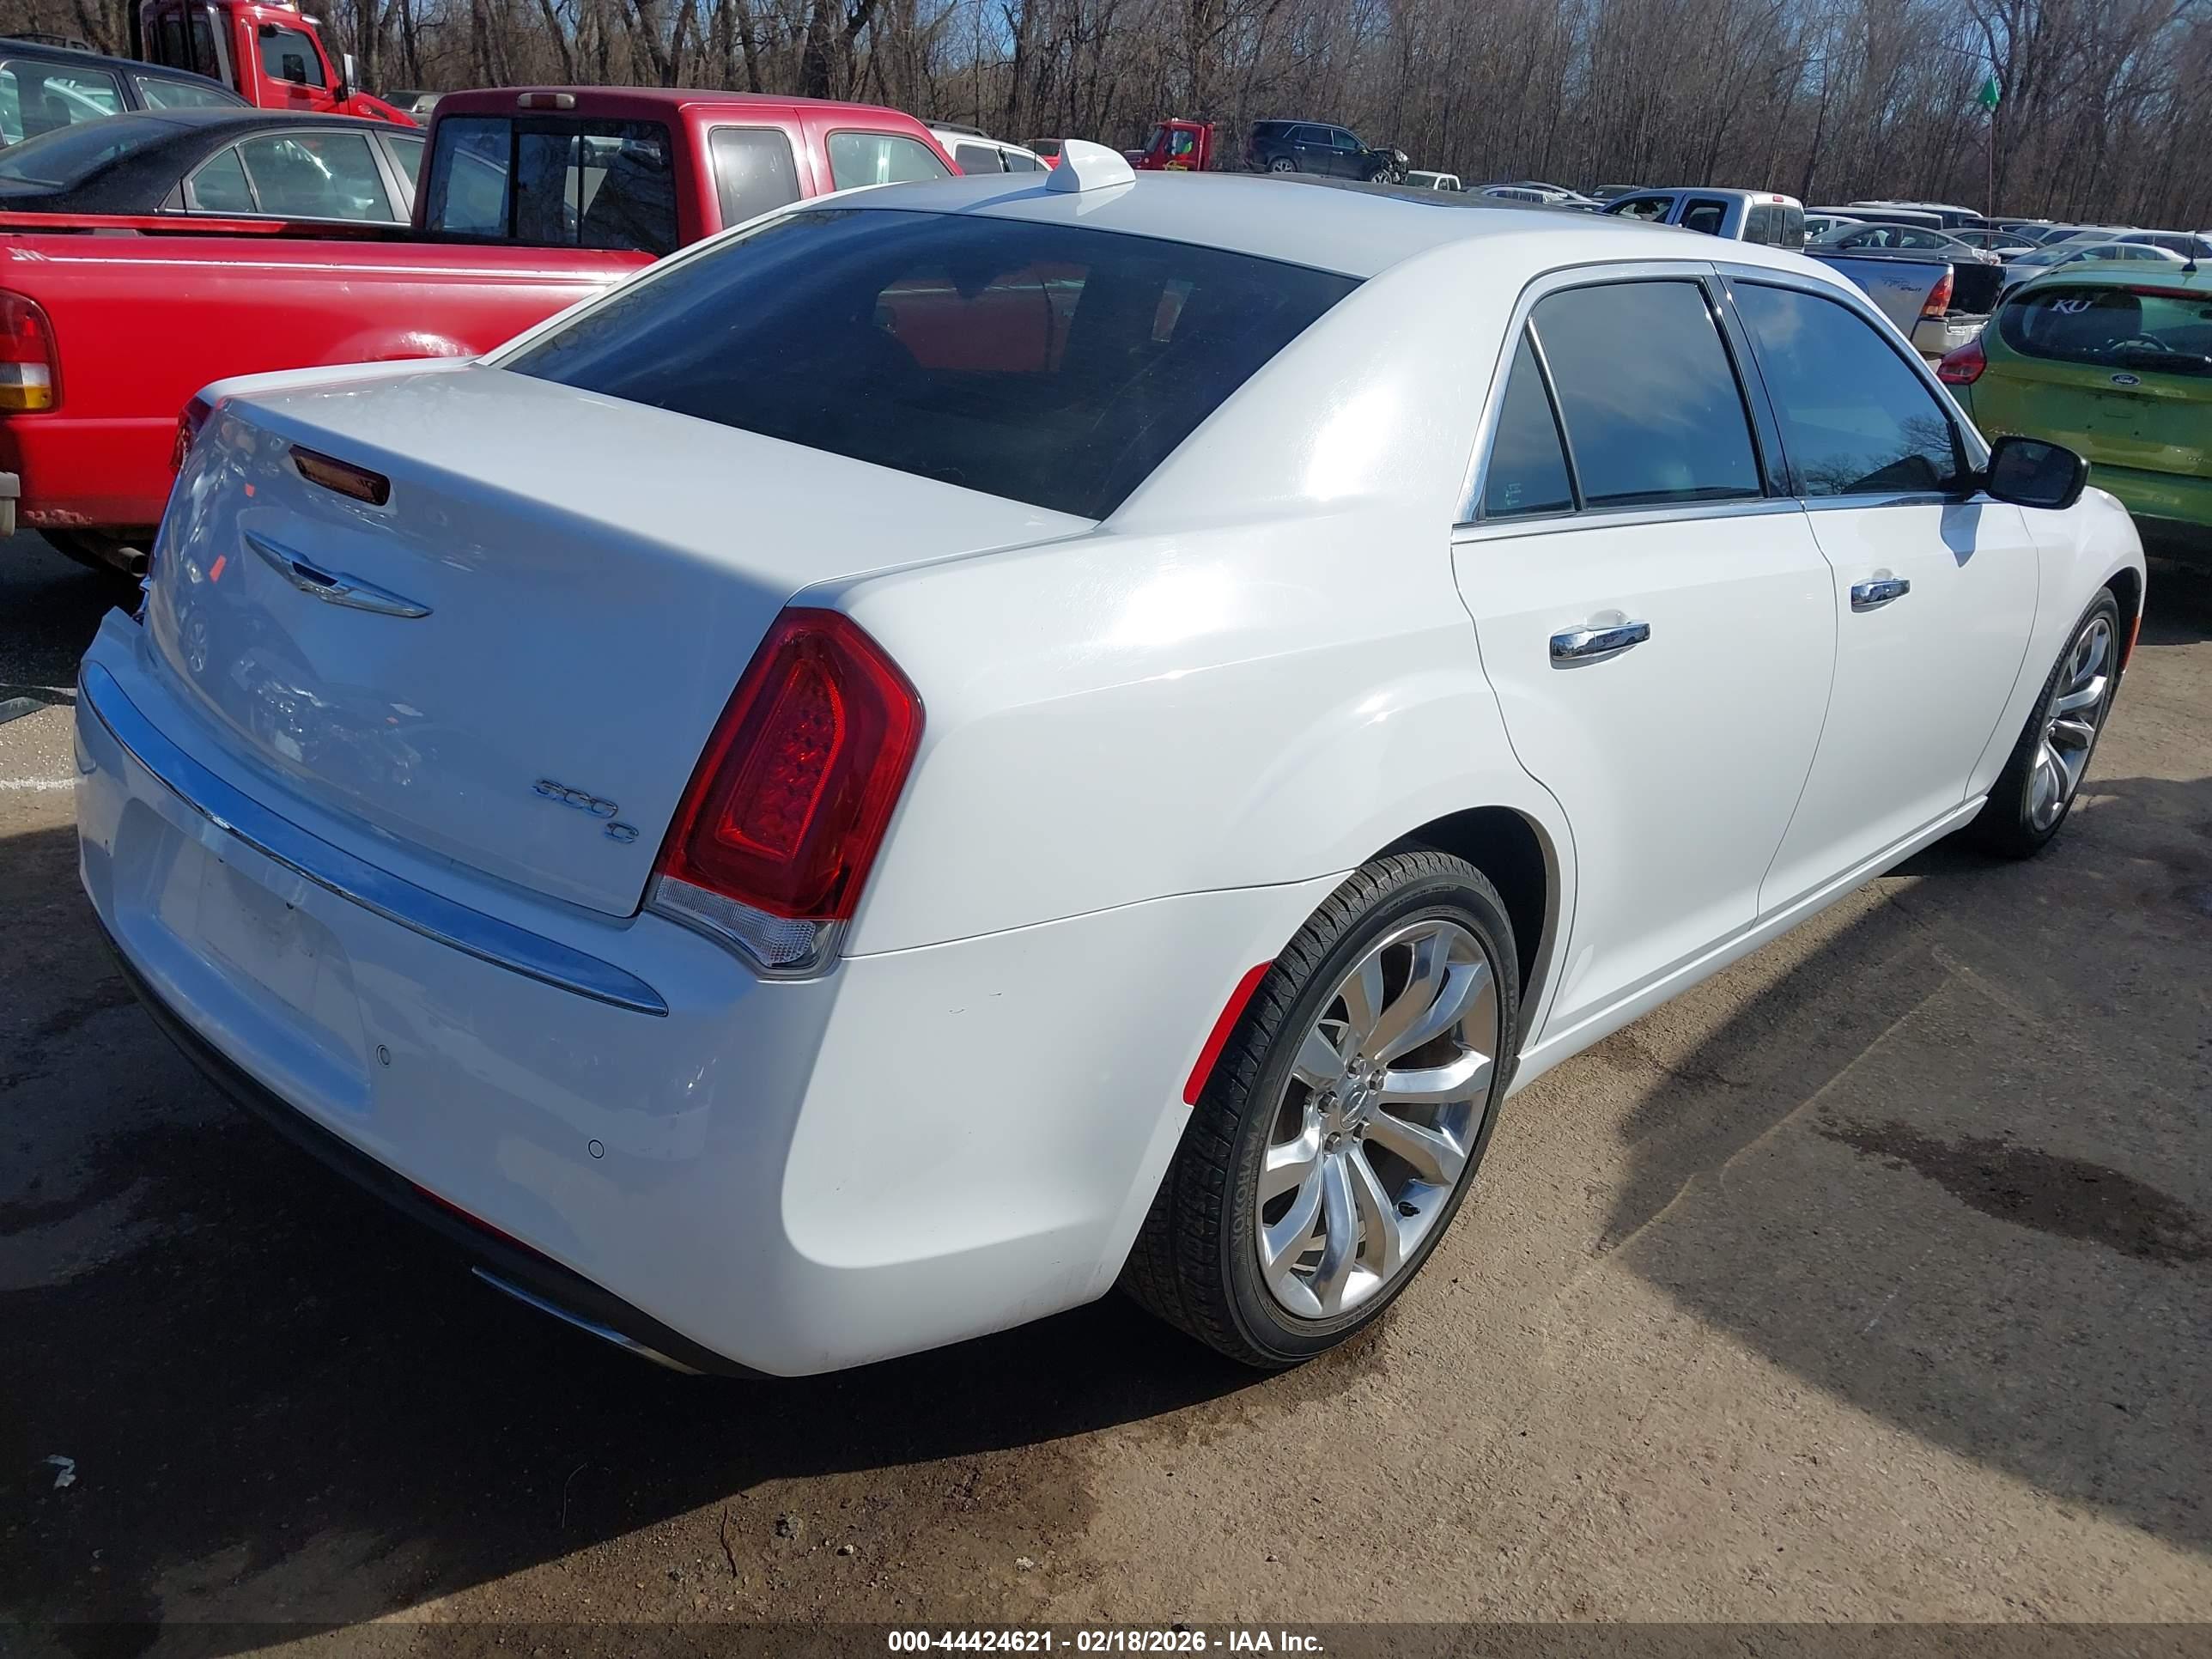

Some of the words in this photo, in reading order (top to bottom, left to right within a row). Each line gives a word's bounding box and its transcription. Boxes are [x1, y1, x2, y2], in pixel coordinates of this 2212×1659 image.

[2051, 299, 2094, 314] KU
[530, 778, 618, 819] 300
[604, 823, 640, 844] C
[1231, 1115, 1264, 1246] YOKOHAMA
